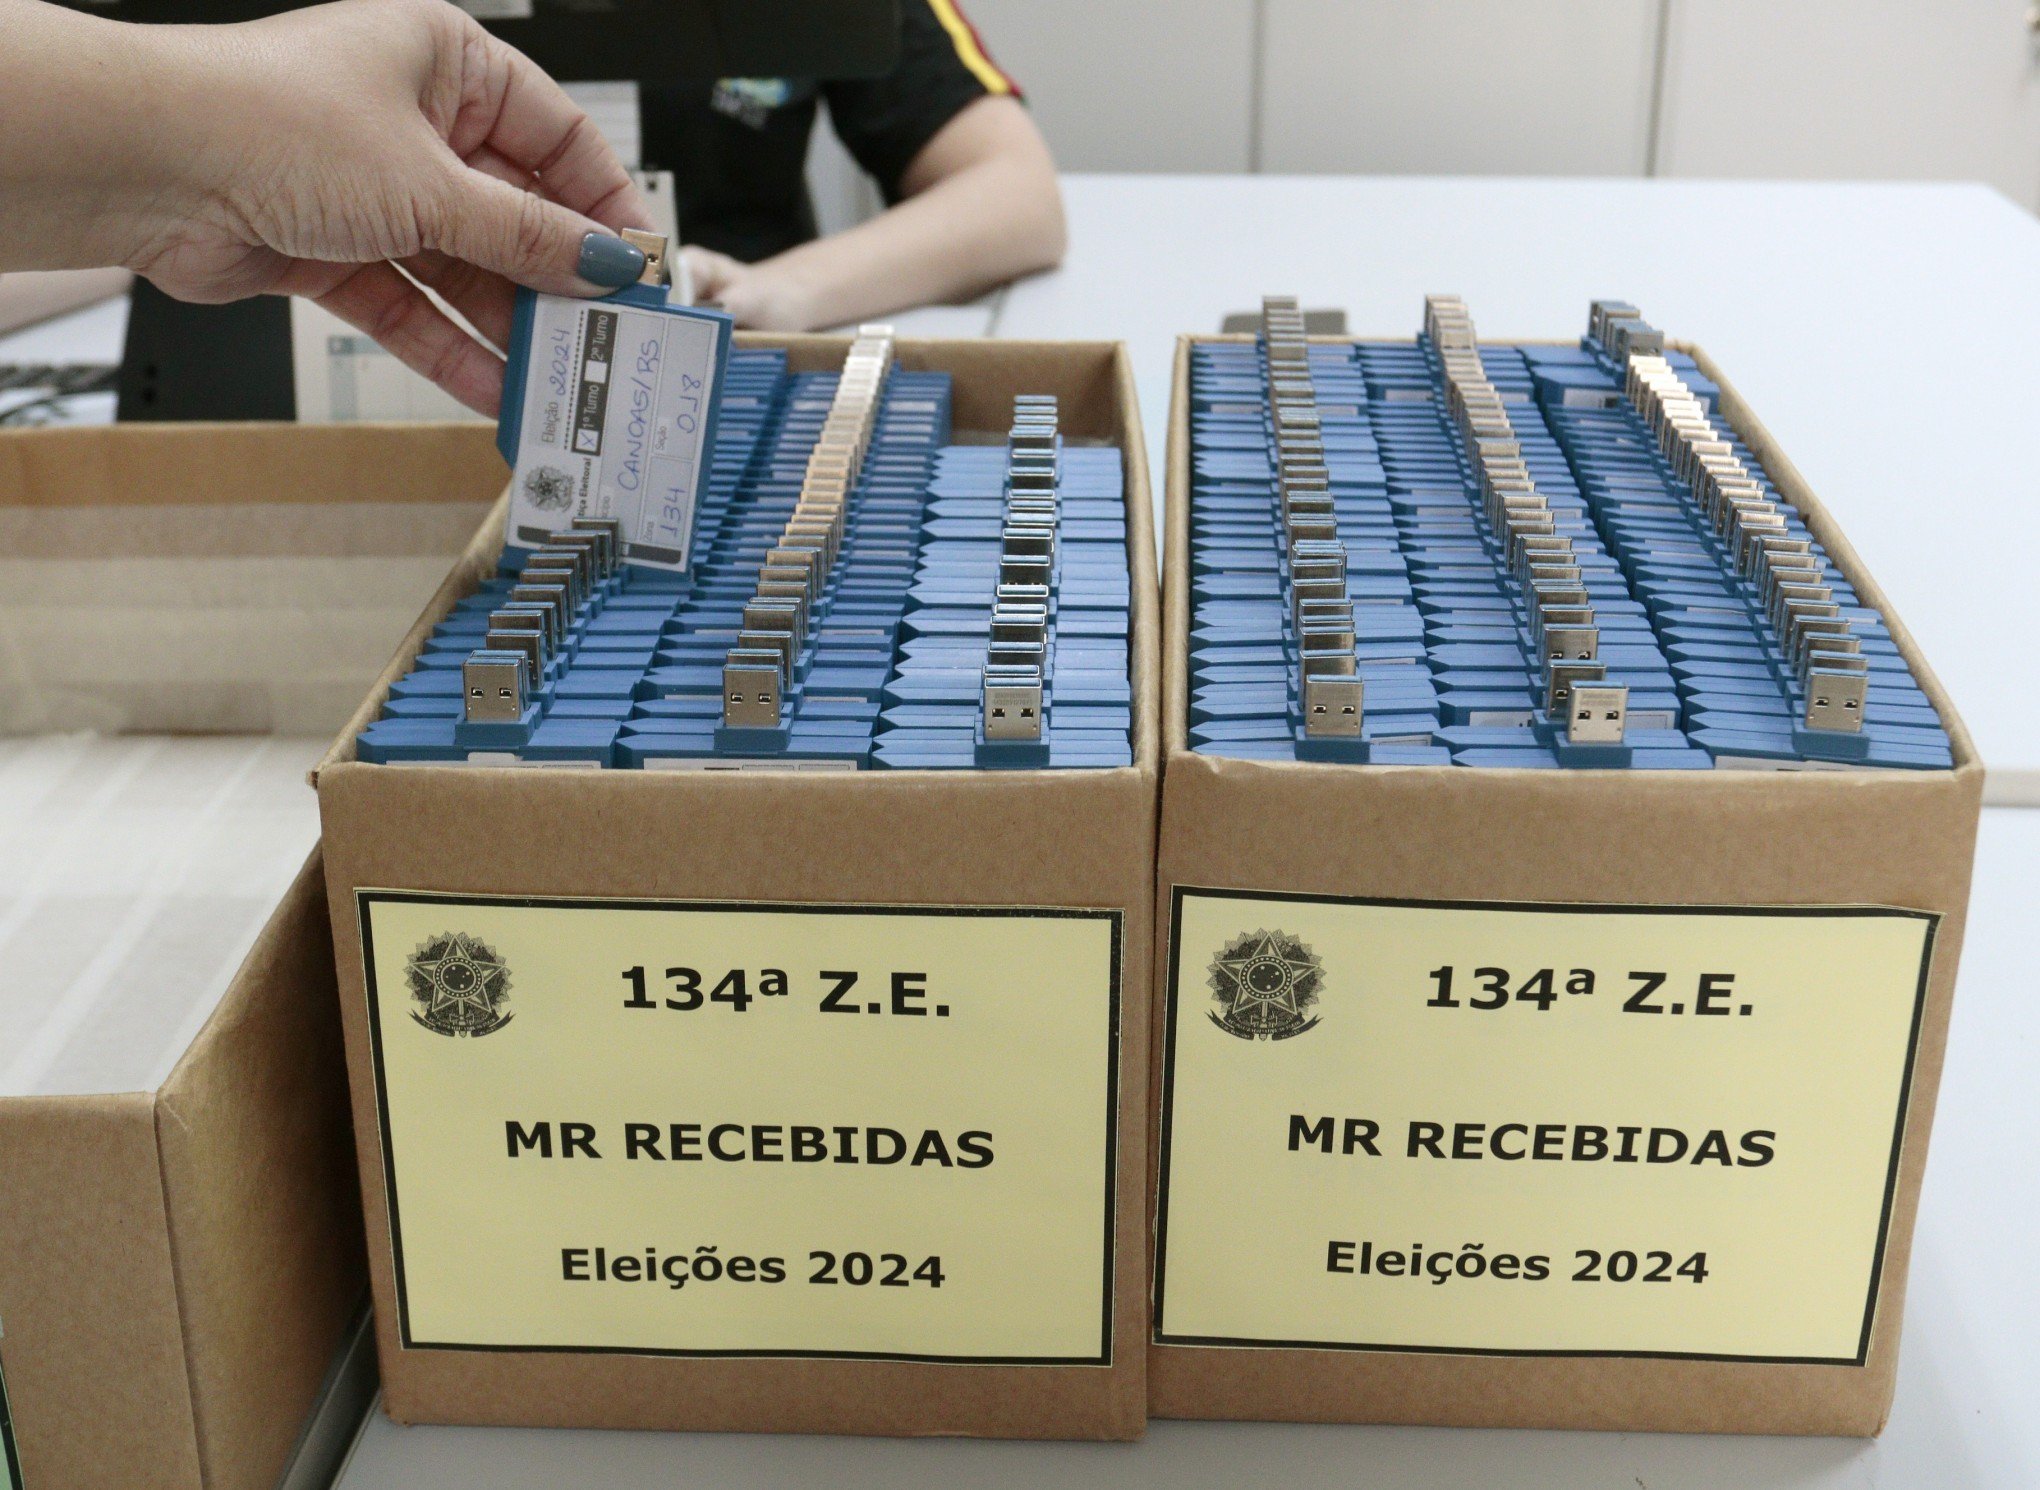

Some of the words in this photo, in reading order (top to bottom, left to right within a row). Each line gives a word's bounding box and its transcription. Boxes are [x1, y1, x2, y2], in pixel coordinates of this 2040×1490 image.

[592, 315, 609, 345] Turno
[549, 328, 571, 396] 2024
[542, 401, 559, 443] Eleição
[583, 385, 600, 414] Turno
[677, 373, 702, 434] 018
[579, 458, 592, 497] Eleitoral
[578, 499, 589, 517] tiça
[658, 487, 685, 537] 134
[819, 970, 950, 1017] Z.E.
[1622, 971, 1753, 1016] Z.E.
[505, 1120, 603, 1159] MR
[624, 1122, 994, 1169] RECEBIDAS
[1288, 1114, 1382, 1157] MR
[1406, 1121, 1776, 1167] RECEBIDAS
[561, 1245, 787, 1290] Eleições
[808, 1250, 946, 1288] 2024
[1326, 1240, 1550, 1286] Eleições
[1571, 1249, 1709, 1284] 2024
